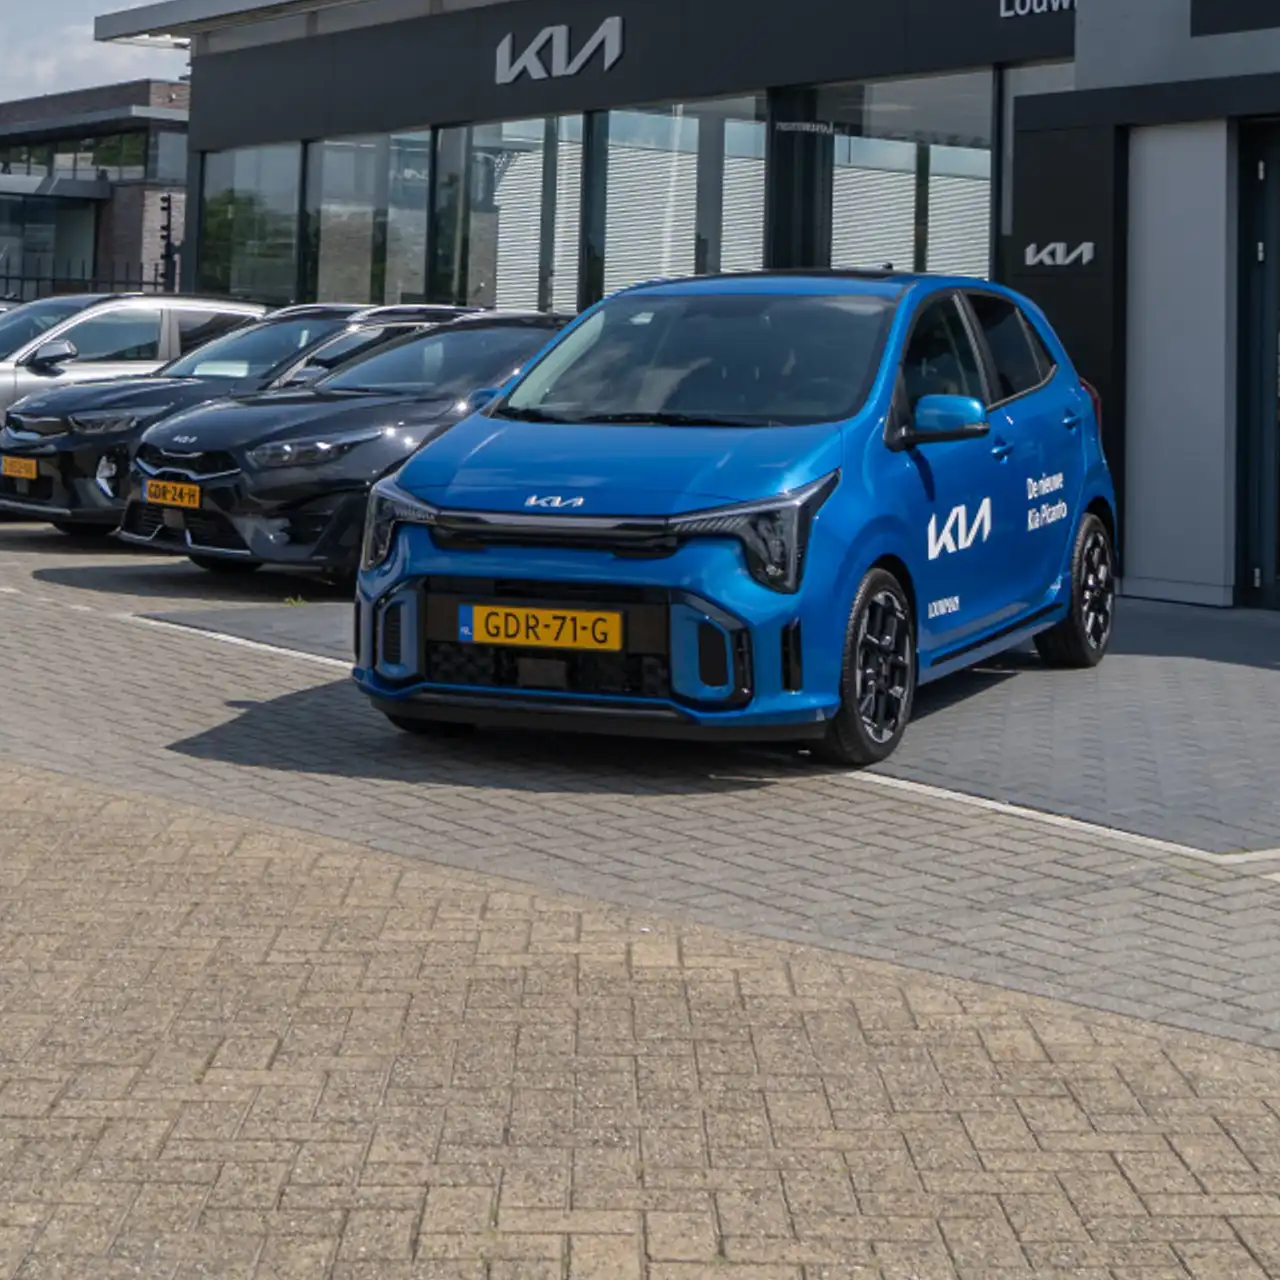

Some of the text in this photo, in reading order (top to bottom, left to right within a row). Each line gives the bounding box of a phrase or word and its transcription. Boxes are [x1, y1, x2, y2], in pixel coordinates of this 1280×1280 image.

[495, 16, 623, 84] KIA
[1024, 242, 1094, 265] KIA
[927, 496, 991, 560] KIA
[485, 611, 608, 644] GDR-71-G
